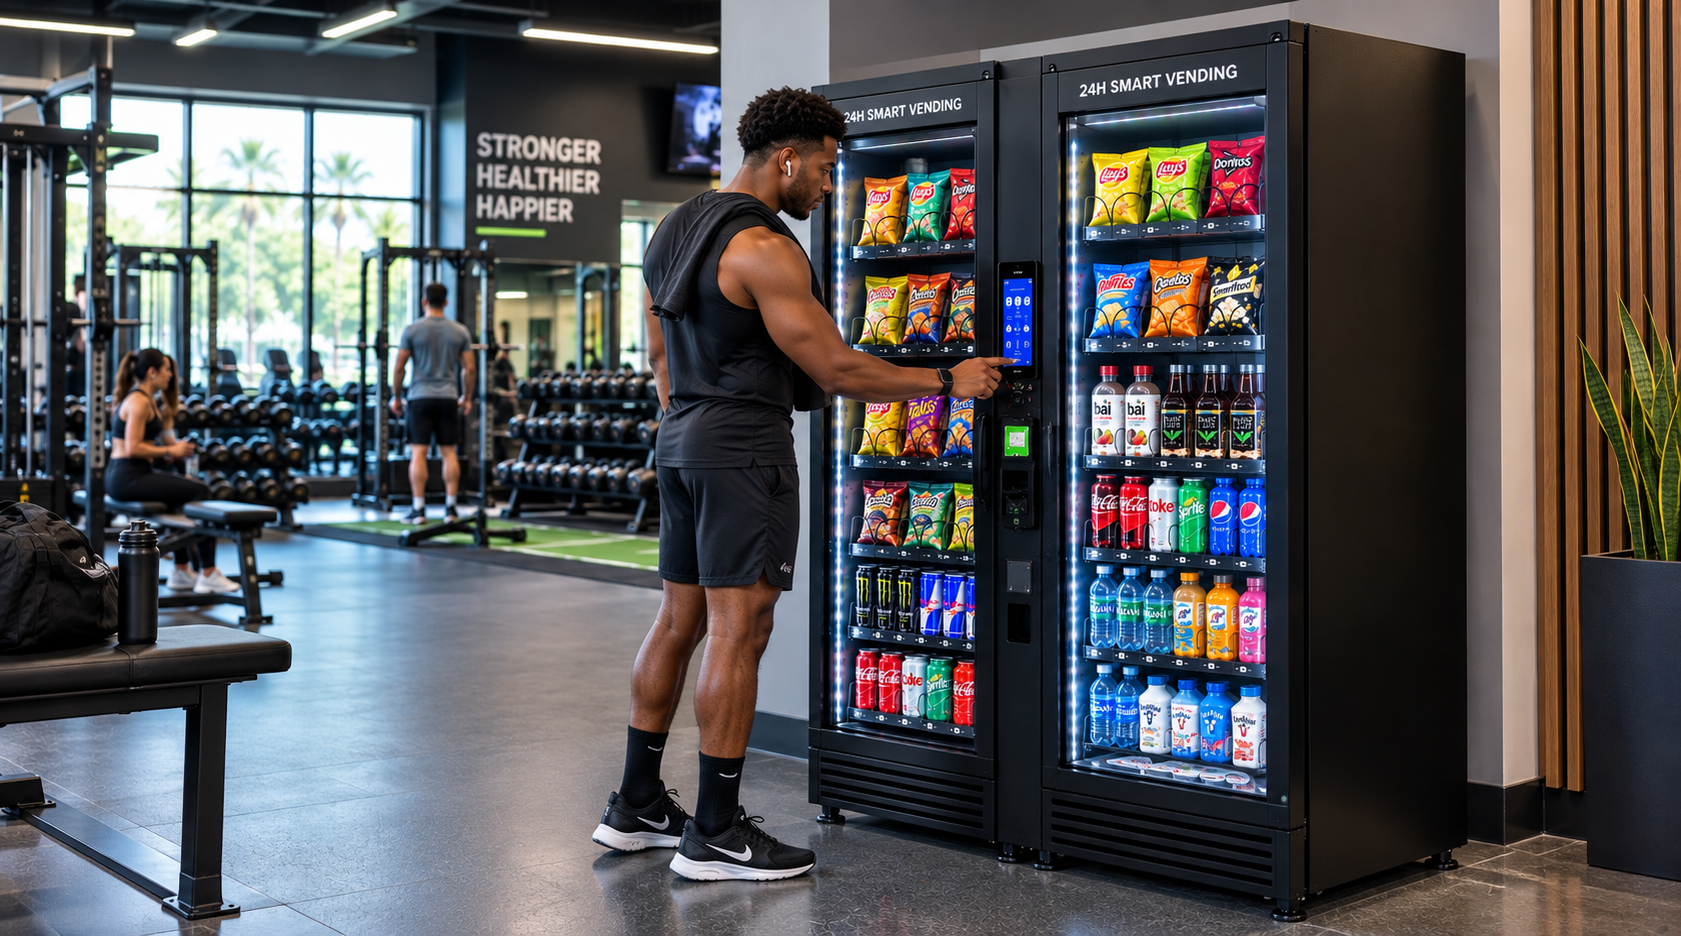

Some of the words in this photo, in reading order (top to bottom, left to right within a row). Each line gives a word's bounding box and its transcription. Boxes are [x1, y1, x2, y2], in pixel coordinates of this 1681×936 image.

[1079, 81, 1106, 98] 24H
[1110, 74, 1162, 93] SMART
[1165, 64, 1238, 87] VENDING
[843, 110, 865, 124] 24H
[867, 104, 906, 121] SMART
[909, 97, 962, 116] VENDING
[477, 132, 602, 165] STRONGER
[476, 163, 600, 195] HEALTHIER
[476, 194, 574, 223] HAPPIER
[1094, 401, 1112, 416] bai
[1127, 401, 1145, 416] bai
